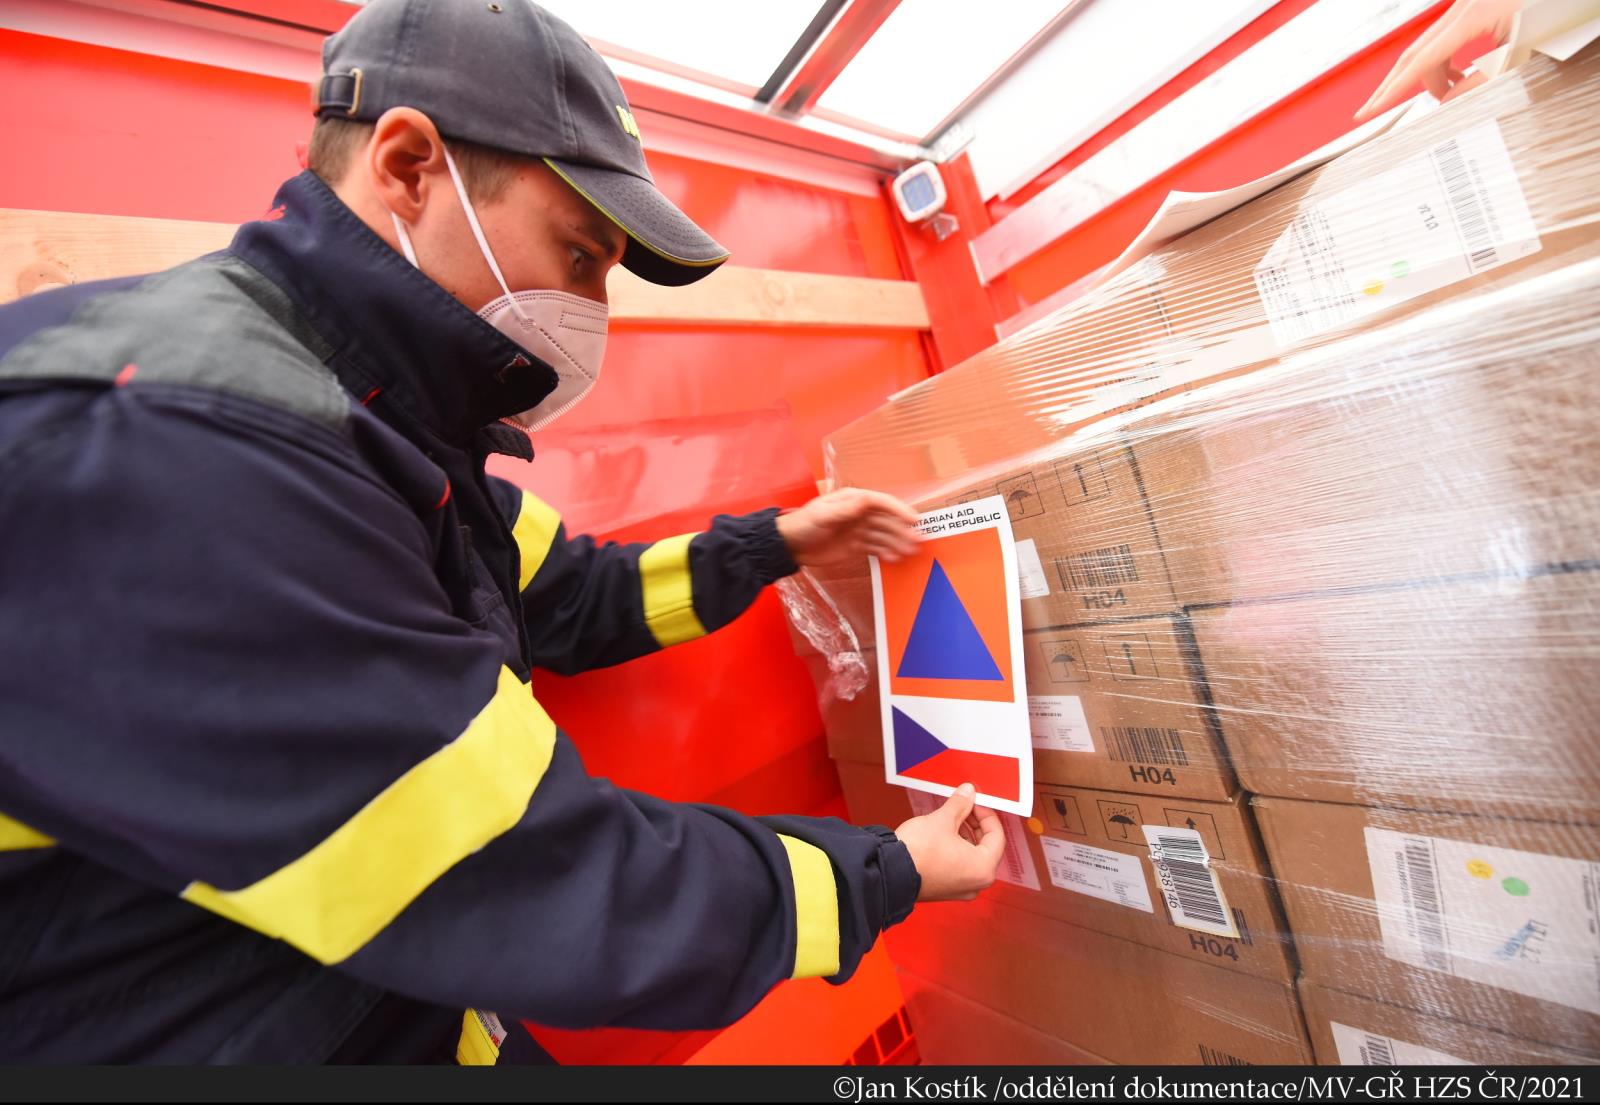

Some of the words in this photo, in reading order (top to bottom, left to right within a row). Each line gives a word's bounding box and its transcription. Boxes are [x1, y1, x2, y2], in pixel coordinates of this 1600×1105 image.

[918, 524, 946, 534] ZECH
[948, 512, 1001, 530] REPUBLIC
[957, 508, 975, 518] AID
[1082, 589, 1127, 610] H04
[1129, 765, 1176, 785] H04
[1188, 933, 1239, 961] H04
